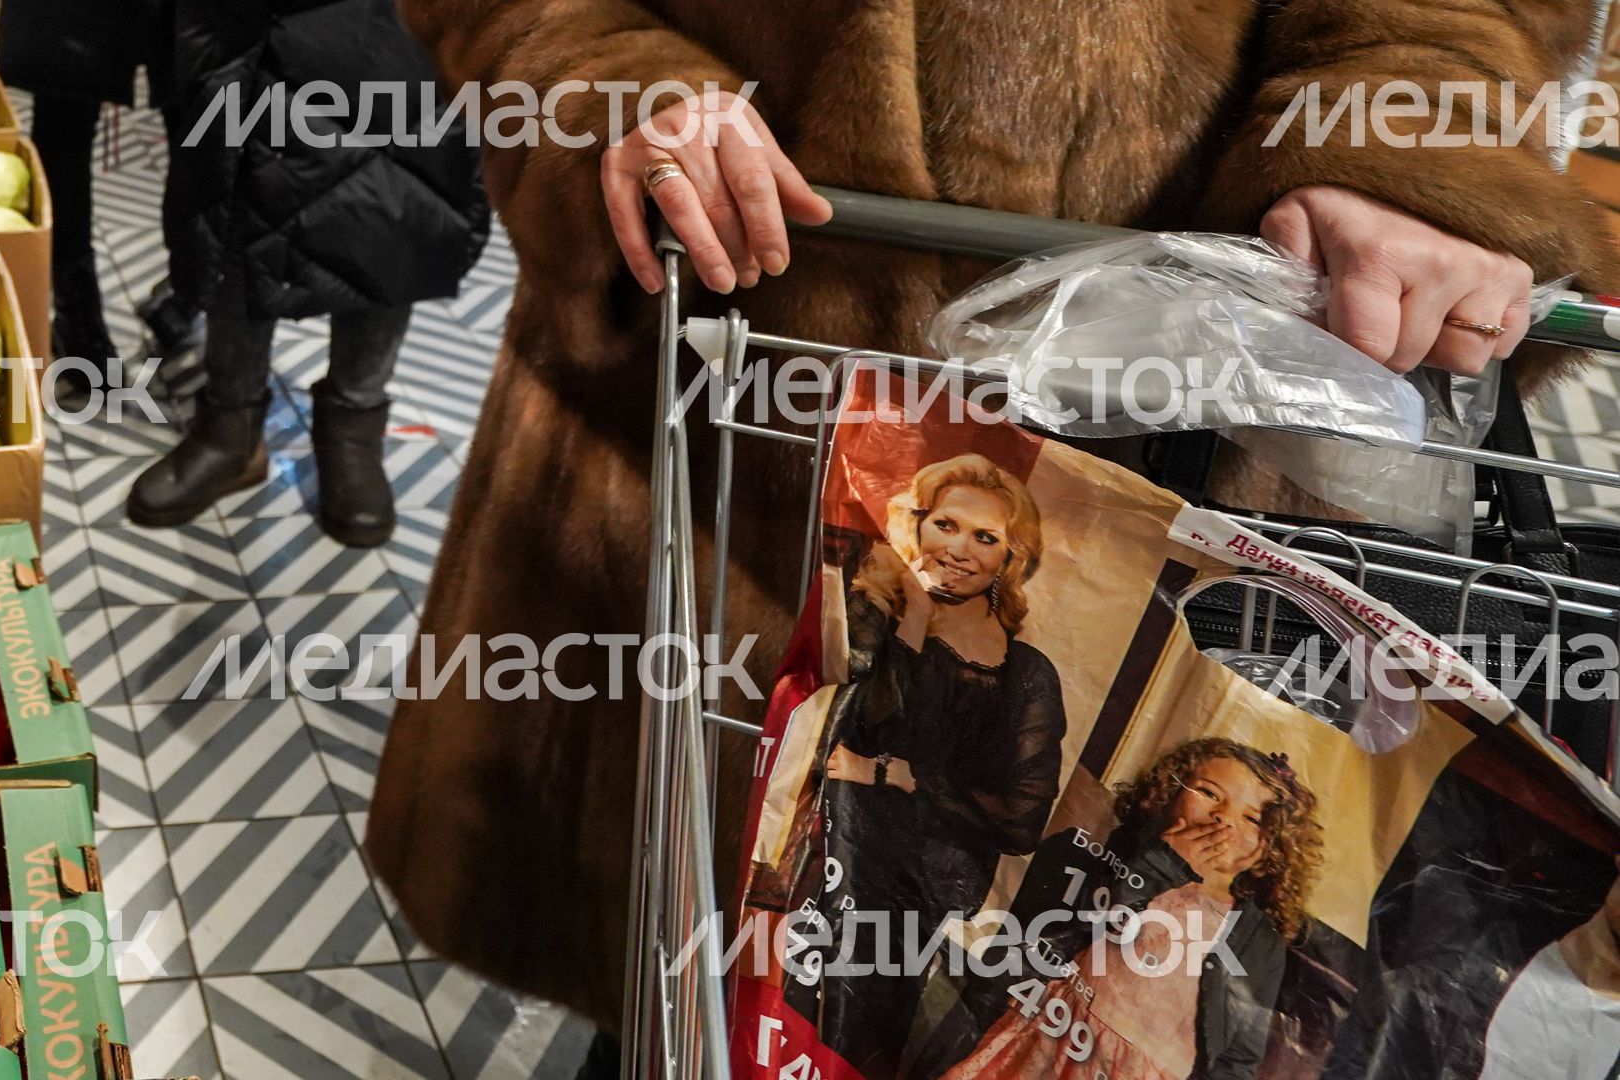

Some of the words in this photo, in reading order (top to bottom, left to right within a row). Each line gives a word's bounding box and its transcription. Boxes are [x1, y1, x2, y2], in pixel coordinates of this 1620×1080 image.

[1071, 826, 1145, 890] Болеро
[1060, 865, 1141, 946] 199
[1031, 936, 1096, 1003] Платье
[1006, 976, 1095, 1063] 499
